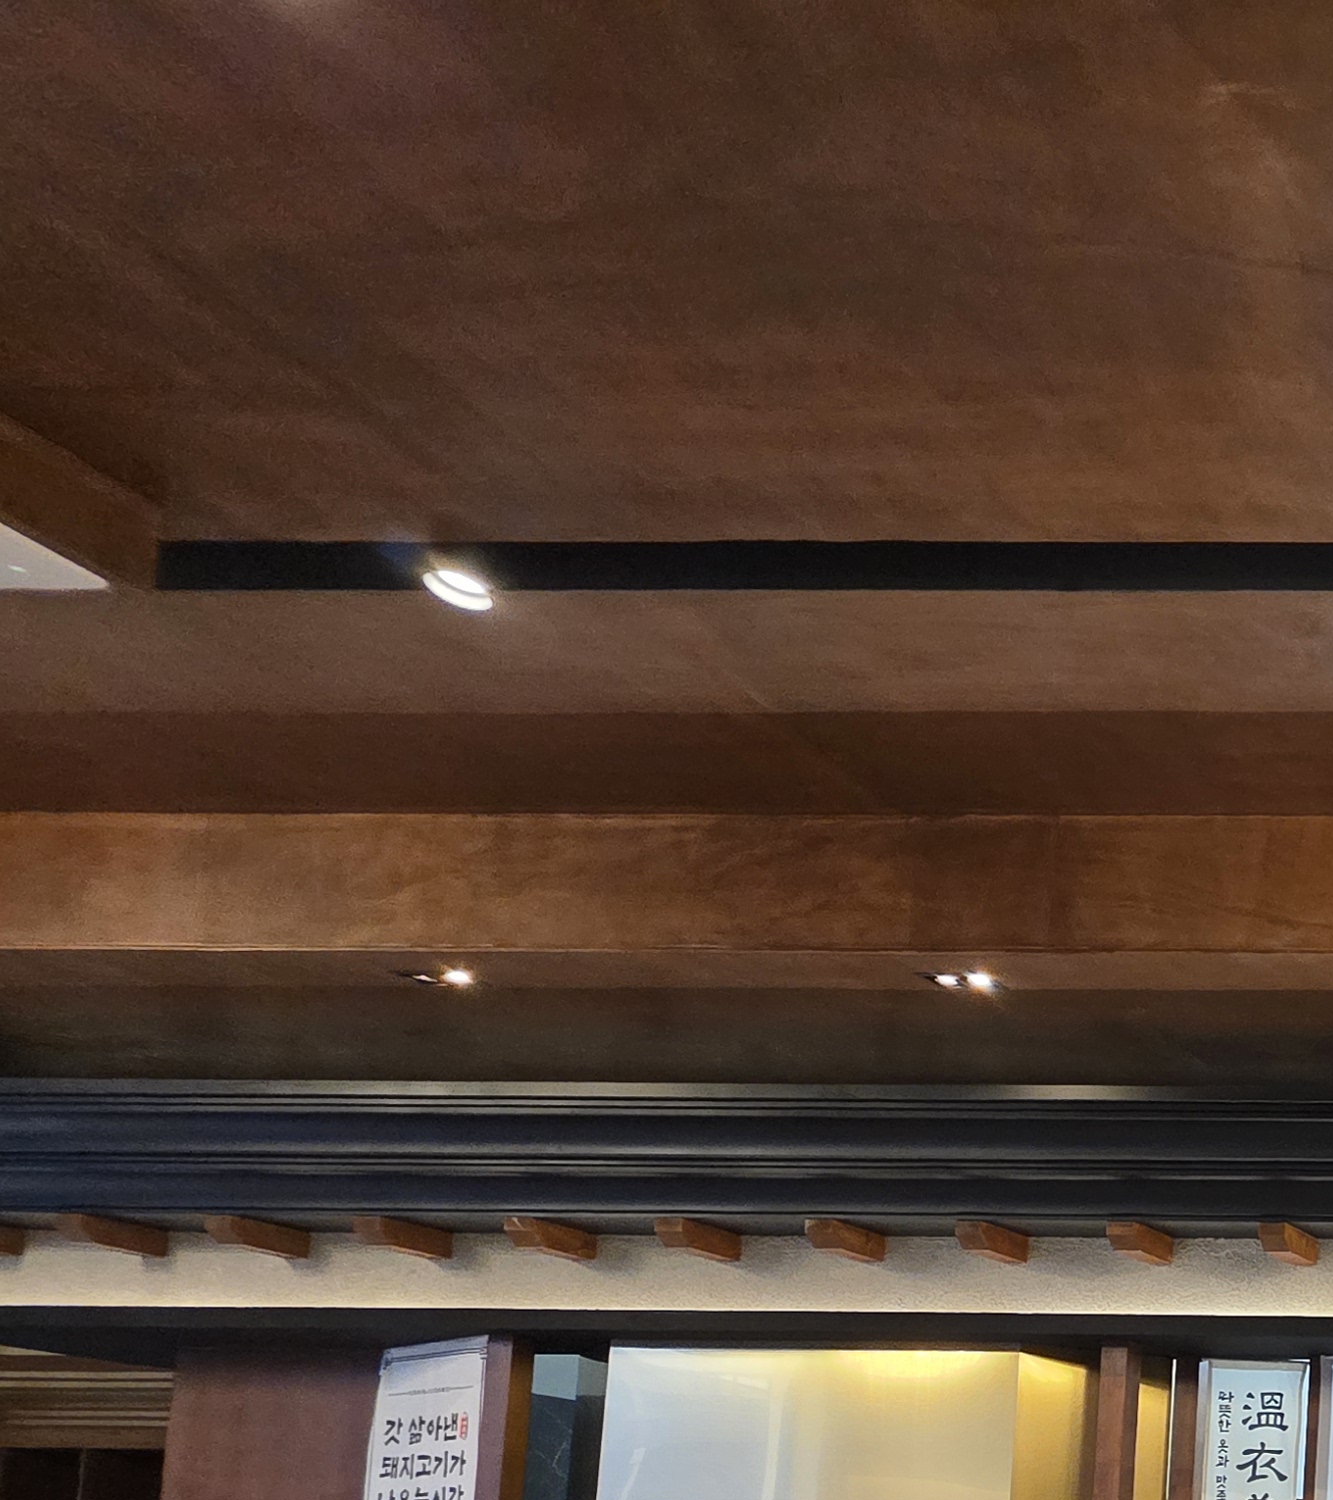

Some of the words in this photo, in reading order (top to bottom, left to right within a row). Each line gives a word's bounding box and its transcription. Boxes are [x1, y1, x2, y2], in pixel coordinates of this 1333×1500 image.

[383, 1417, 403, 1446] 갓
[408, 1413, 459, 1445] 삶아낸
[379, 1450, 467, 1480] 돼지고기가
[1215, 1438, 1230, 1468] 옷과
